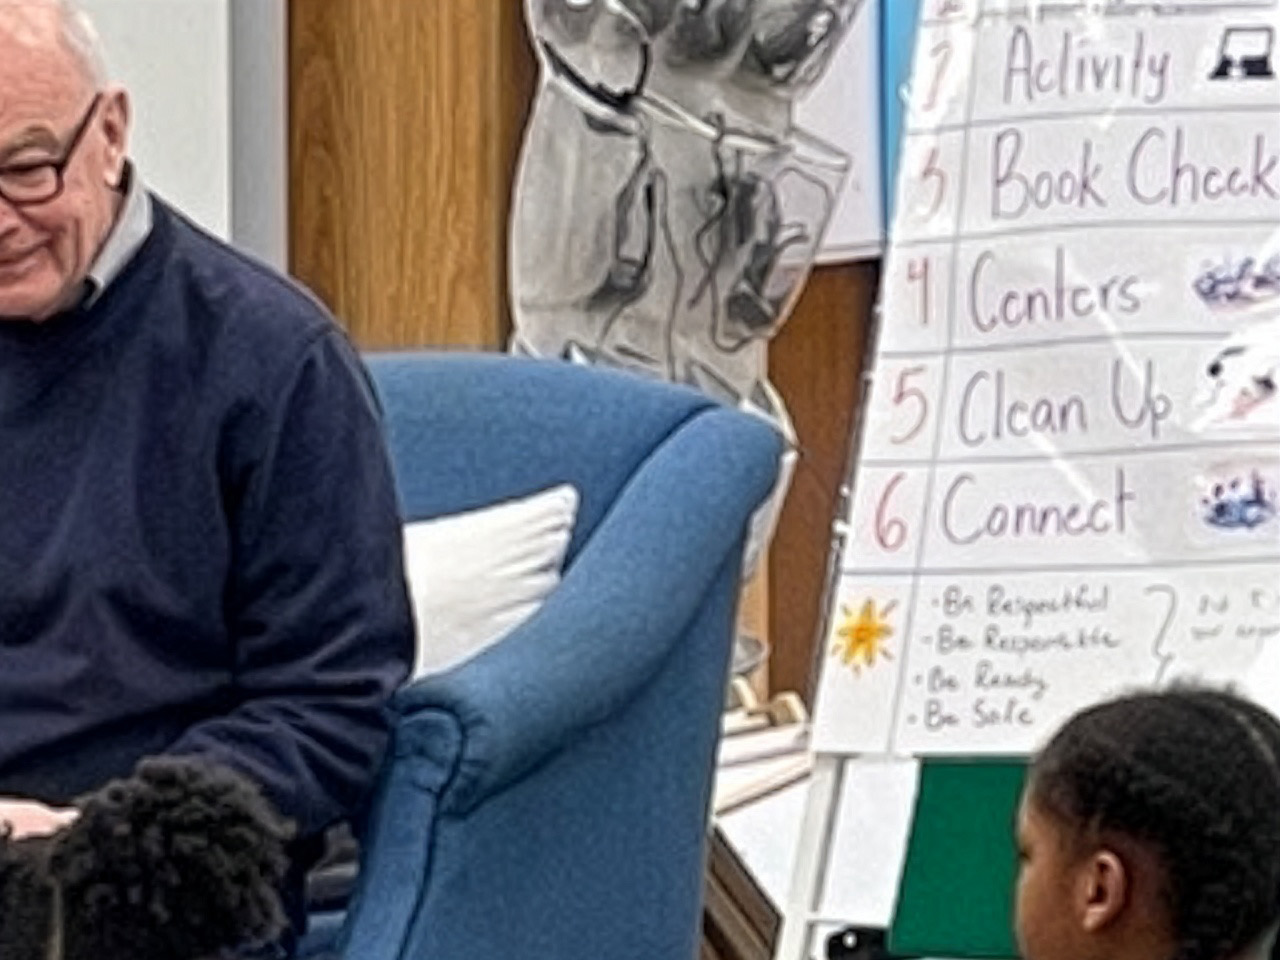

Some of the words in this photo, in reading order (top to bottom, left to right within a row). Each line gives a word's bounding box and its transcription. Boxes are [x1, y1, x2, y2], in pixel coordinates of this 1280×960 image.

[1004, 25, 1172, 104] Activity
[992, 126, 1108, 220] Book
[1127, 126, 1280, 207] Check
[907, 257, 930, 326] 4
[969, 244, 1142, 334] Centers
[890, 365, 928, 446] 5
[957, 368, 1088, 448] Clean
[1112, 358, 1173, 440] Up
[874, 470, 908, 552] 6
[941, 466, 1136, 547] Connect
